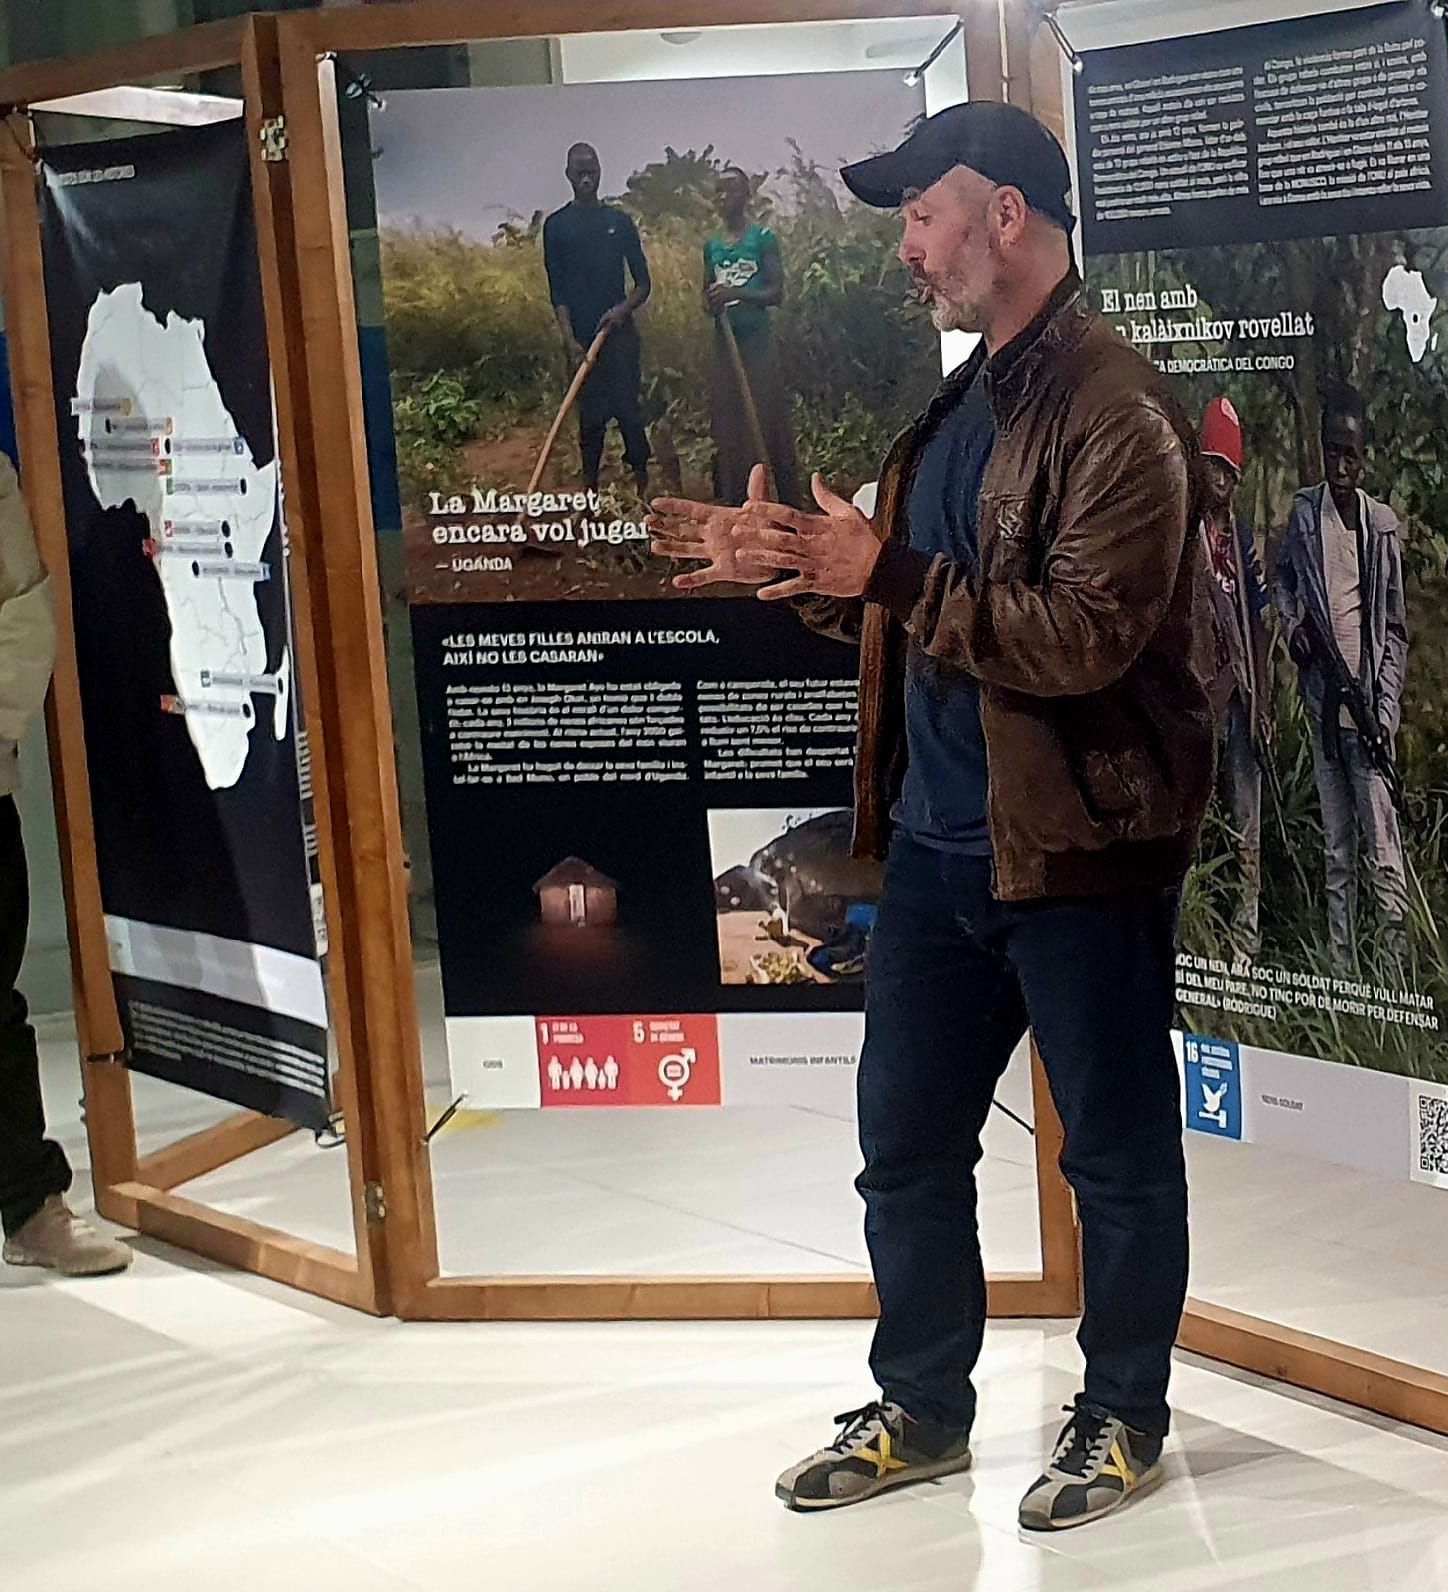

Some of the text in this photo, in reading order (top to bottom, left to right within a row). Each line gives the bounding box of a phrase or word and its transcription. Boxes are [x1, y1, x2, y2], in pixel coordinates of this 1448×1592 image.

[1101, 284, 1198, 312] El nen amb
[1131, 316, 1235, 343] kalàixnikov
[1238, 311, 1314, 339] rovellat
[1236, 356, 1254, 371] DEL
[1255, 355, 1294, 370] CONGO
[429, 488, 600, 517] La Margaret
[432, 522, 527, 544] encara
[532, 518, 577, 541] vol
[452, 556, 512, 572] UGANDA
[443, 652, 473, 665] AIXÍ
[476, 651, 499, 664] NO
[502, 651, 527, 664] LES
[1252, 966, 1273, 982] SOC
[1275, 970, 1291, 986] UN
[1292, 973, 1331, 990] SOLDAT
[1373, 986, 1398, 1004] VULL
[1399, 990, 1434, 1010] MATAR
[1269, 987, 1293, 1003] TINC
[1295, 991, 1316, 1008] POR
[1367, 1004, 1385, 1020] PER
[1387, 1008, 1439, 1031] DEFENSAR
[540, 1022, 549, 1045] 1
[633, 1021, 645, 1044] 5
[1185, 1040, 1199, 1063] 16
